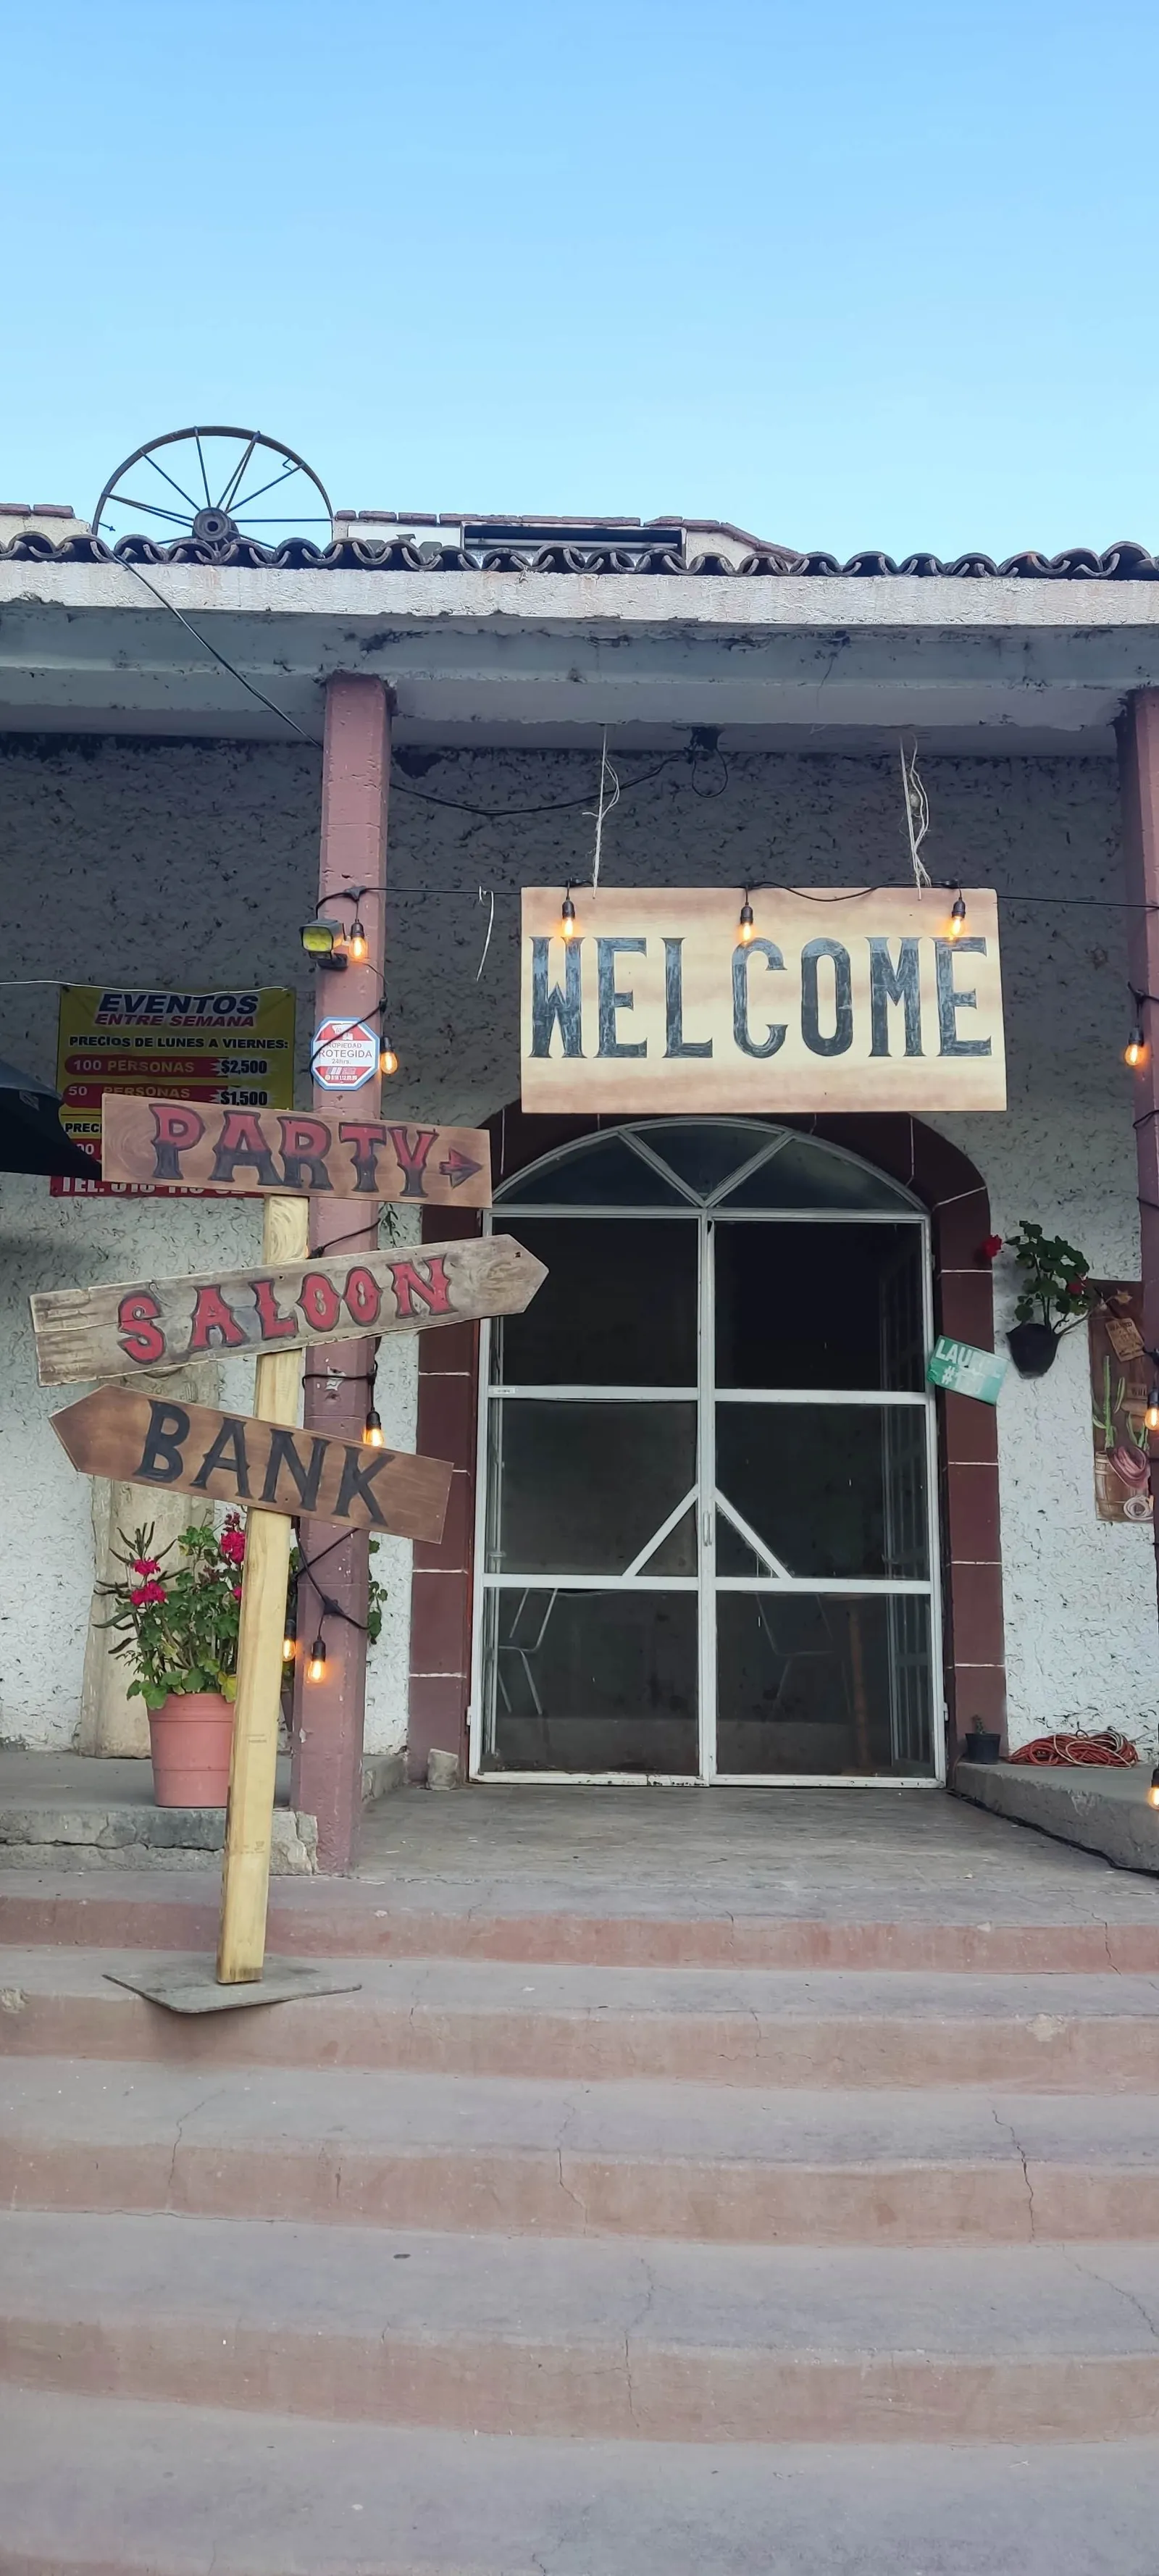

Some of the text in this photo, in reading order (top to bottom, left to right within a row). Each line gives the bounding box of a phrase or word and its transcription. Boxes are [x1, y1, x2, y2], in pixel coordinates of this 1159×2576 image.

[99, 994, 259, 1014] EVENTOS
[530, 936, 992, 1058] WELCOME
[94, 1013, 254, 1027] ENTRE SEMANA
[69, 1036, 289, 1050] PRECIOS DE LUNES A VIERNES:
[319, 1050, 372, 1058] ROTEGIDA
[73, 1059, 267, 1075] 100 PERSONAS $2,500
[68, 1086, 88, 1096] 50
[220, 1091, 268, 1106] $1,500
[148, 1103, 439, 1197] PARTY
[117, 1253, 459, 1364] SALOON
[133, 1399, 396, 1527] BANK
